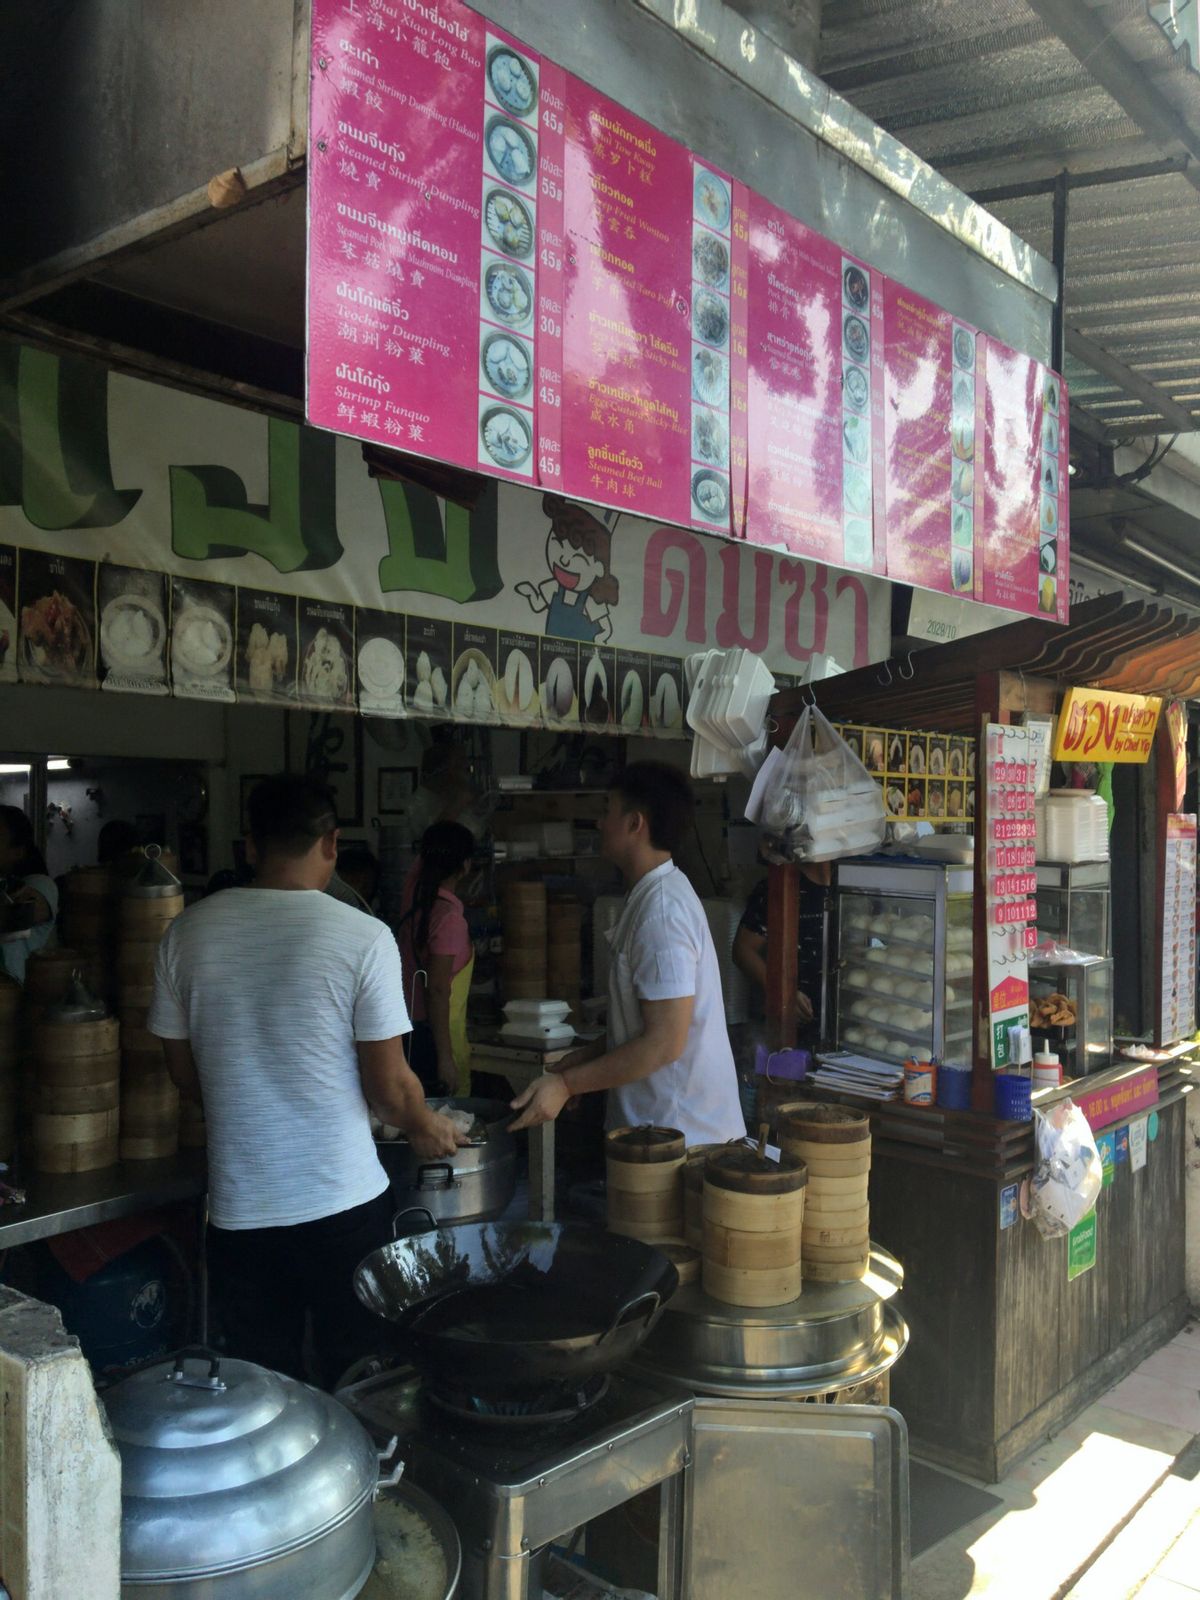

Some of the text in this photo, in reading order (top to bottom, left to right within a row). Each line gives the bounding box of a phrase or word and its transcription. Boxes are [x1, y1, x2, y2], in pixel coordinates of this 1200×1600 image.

[431, 31, 458, 57] Long
[461, 48, 481, 68] Bao
[377, 78, 407, 106] Shrimp
[408, 96, 448, 128] Dumpling
[448, 116, 480, 143] (Hakao)
[337, 121, 406, 163] ขนมจีบกุ้ง
[338, 139, 480, 219] Steamed Shrimp Dumpling
[337, 222, 368, 244] Steamed
[446, 267, 479, 294] Dumpling
[336, 303, 450, 358] Teochew Dumpling
[335, 385, 430, 423] Shrimp Funquo
[588, 444, 644, 471] ลูกชิ้นเนื้อวัว
[588, 461, 663, 488] Steamed Beef Ball
[1114, 738, 1124, 755] by
[1016, 769, 1026, 782] 31
[996, 824, 1036, 838] 21 22 23 24
[997, 852, 1035, 866] 17 18 19 20
[997, 881, 1005, 894] 13
[1016, 880, 1026, 892] 15
[1026, 878, 1036, 890] 16
[1007, 908, 1015, 920] 10
[1016, 907, 1025, 920] 11
[1026, 905, 1036, 918] 12
[1028, 932, 1034, 945] 8
